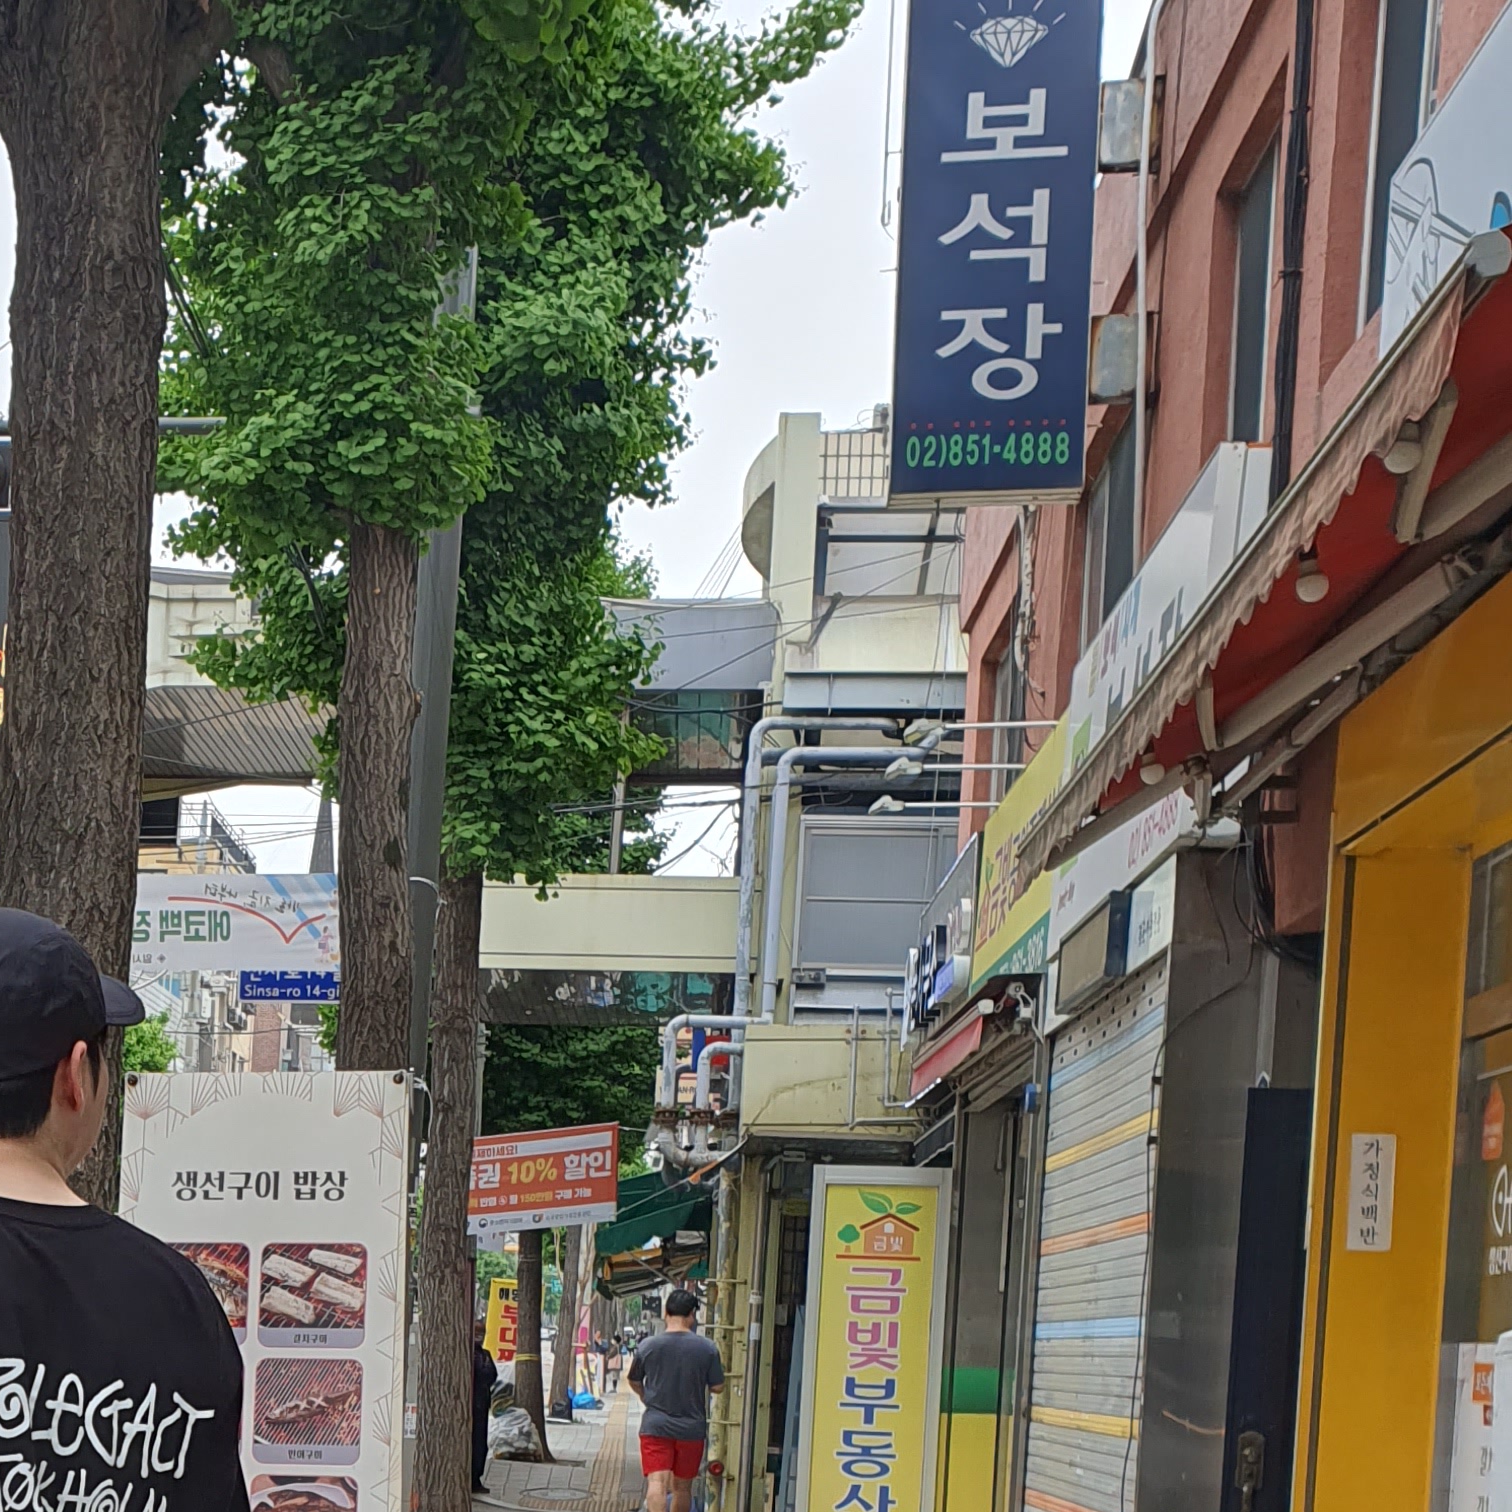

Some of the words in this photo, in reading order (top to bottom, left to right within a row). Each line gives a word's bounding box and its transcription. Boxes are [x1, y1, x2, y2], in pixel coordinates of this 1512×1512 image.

[935, 87, 1069, 401] 보석장
[906, 430, 1071, 468] 02)851-4888
[244, 984, 301, 999] Sinsa-ro
[507, 1157, 558, 1185] 10%
[563, 1150, 612, 1182] 할인
[171, 1170, 281, 1202] 생선구이
[293, 1170, 349, 1202] 밥상
[1359, 1137, 1383, 1246] 가정식백반
[872, 1235, 904, 1253] 금빛
